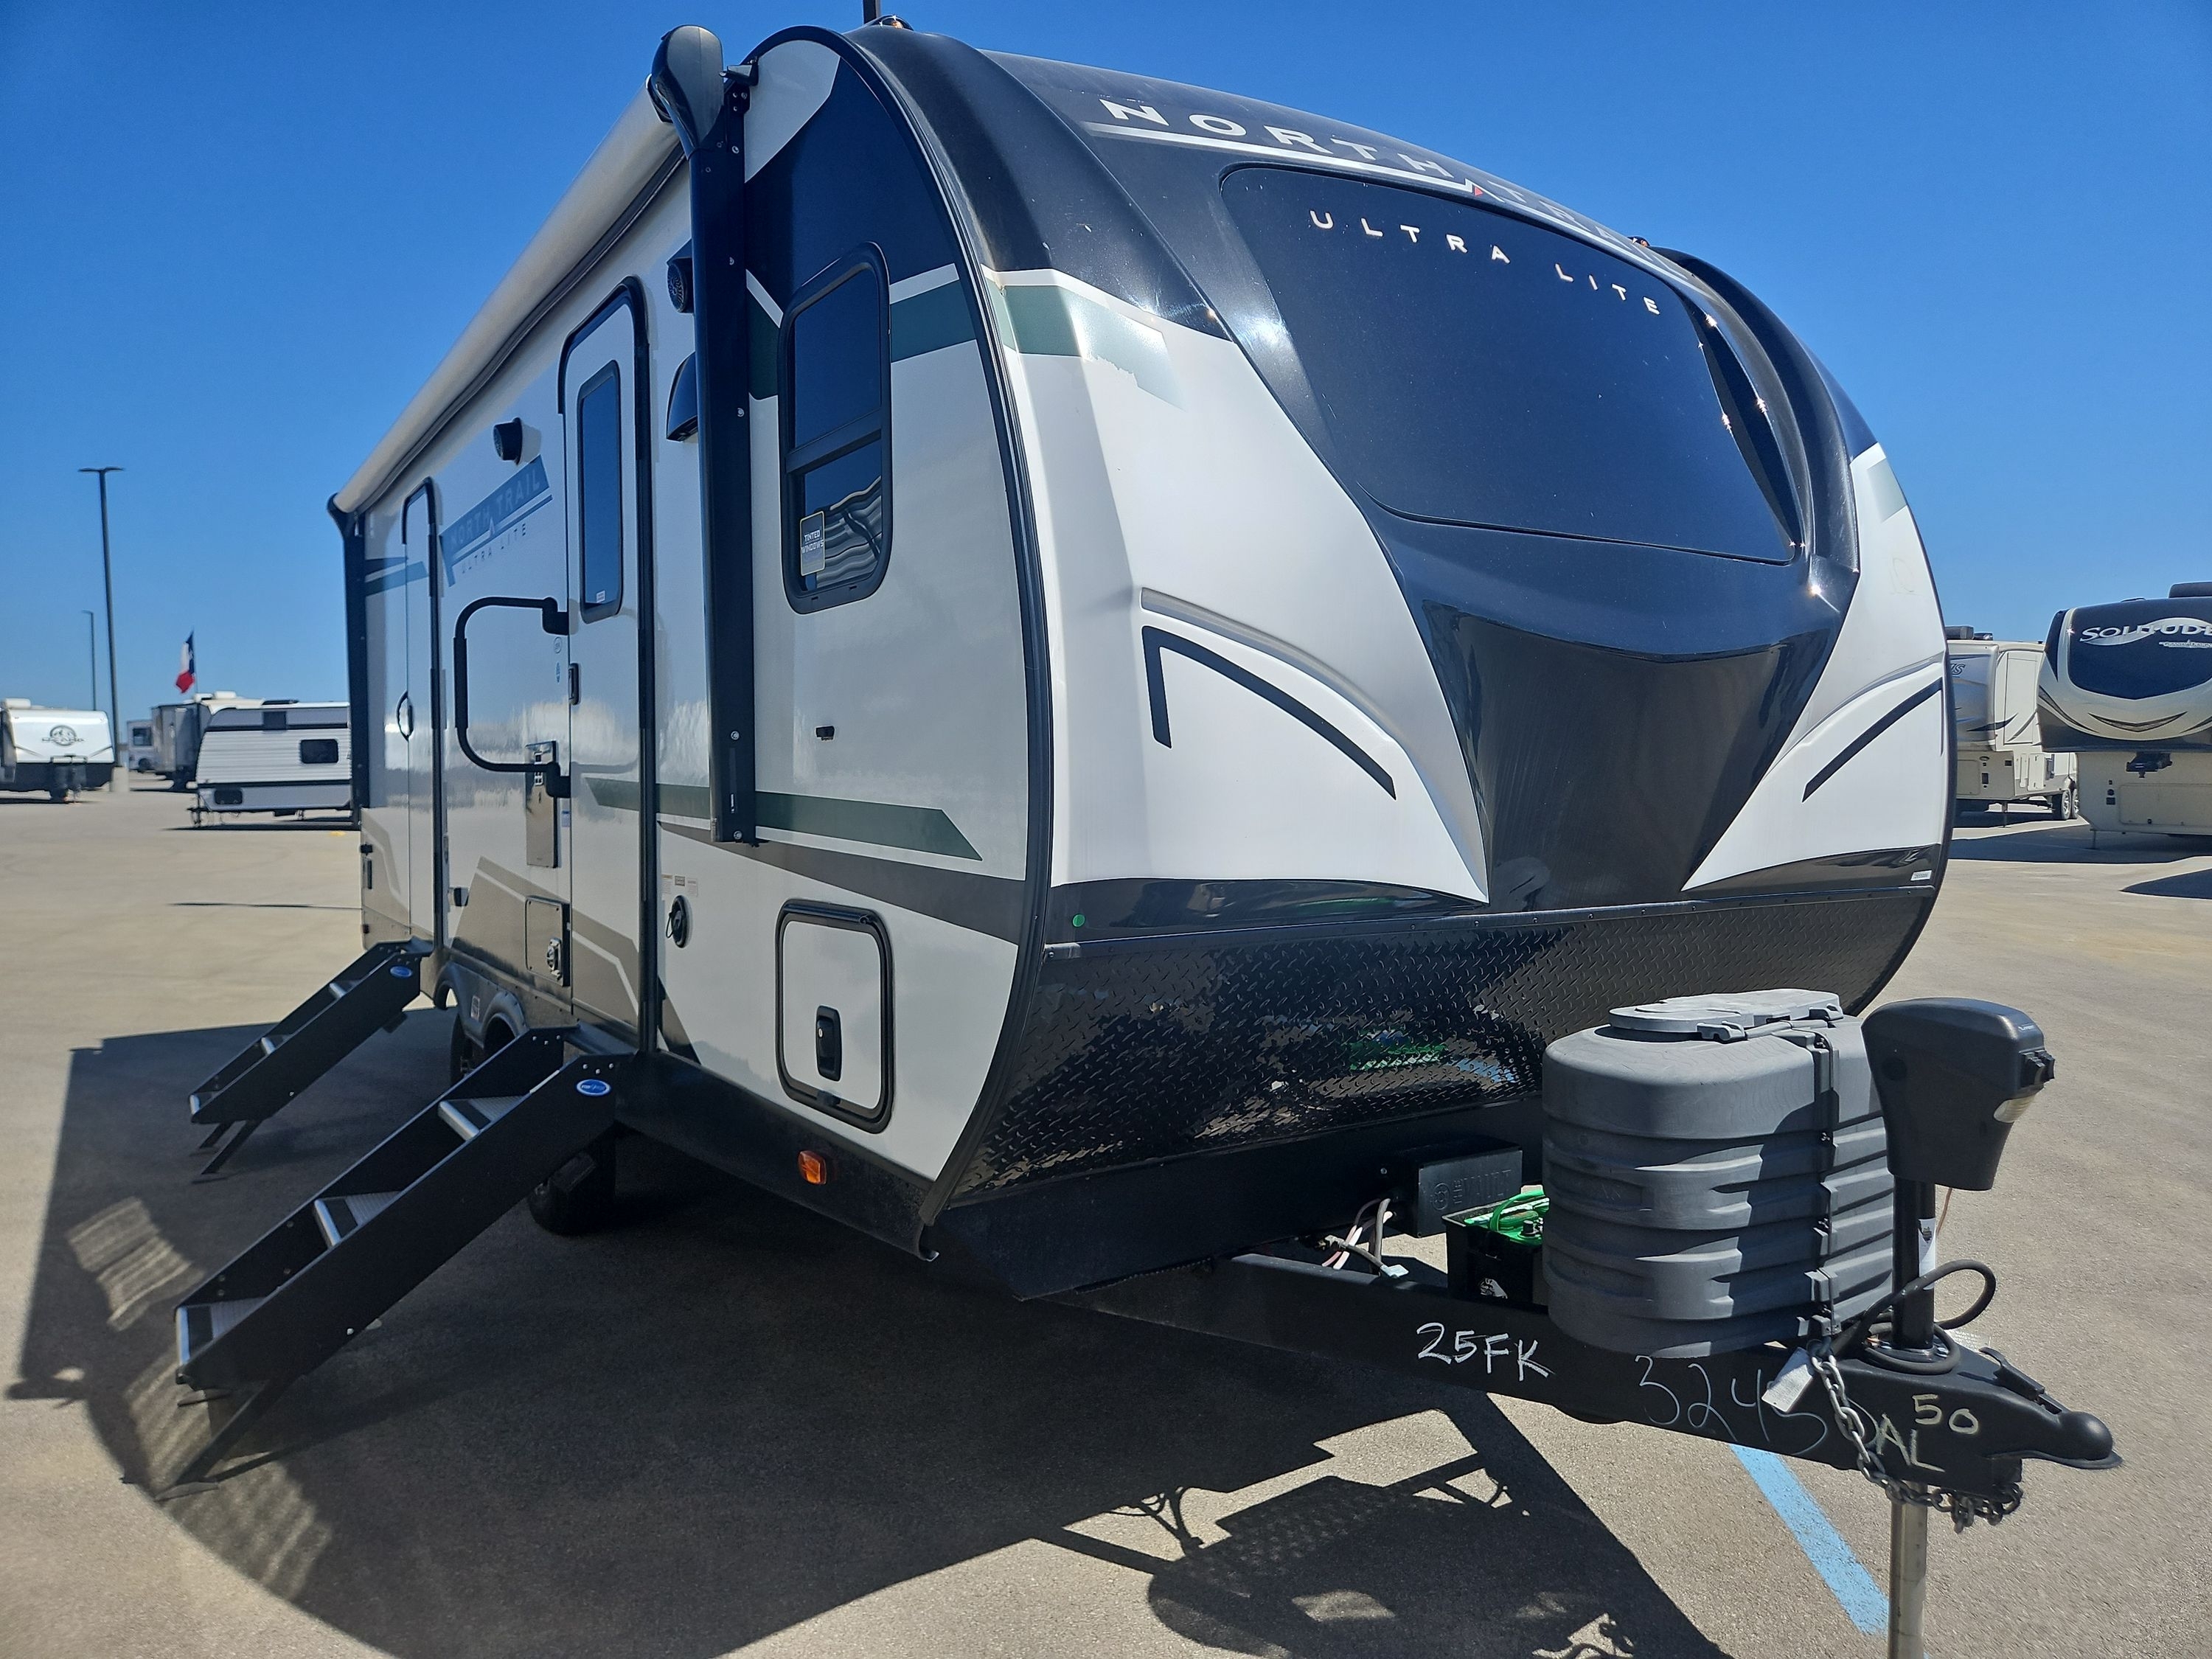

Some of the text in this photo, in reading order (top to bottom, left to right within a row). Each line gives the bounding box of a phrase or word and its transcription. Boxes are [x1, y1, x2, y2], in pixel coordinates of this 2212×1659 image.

[1099, 97, 1452, 178] NORTH
[1310, 209, 1660, 316] ULTRA LITE
[496, 469, 541, 515] TRAIL
[804, 529, 821, 543] TINTED
[1416, 1322, 1558, 1382] 25FK
[1911, 1393, 1980, 1436] 50
